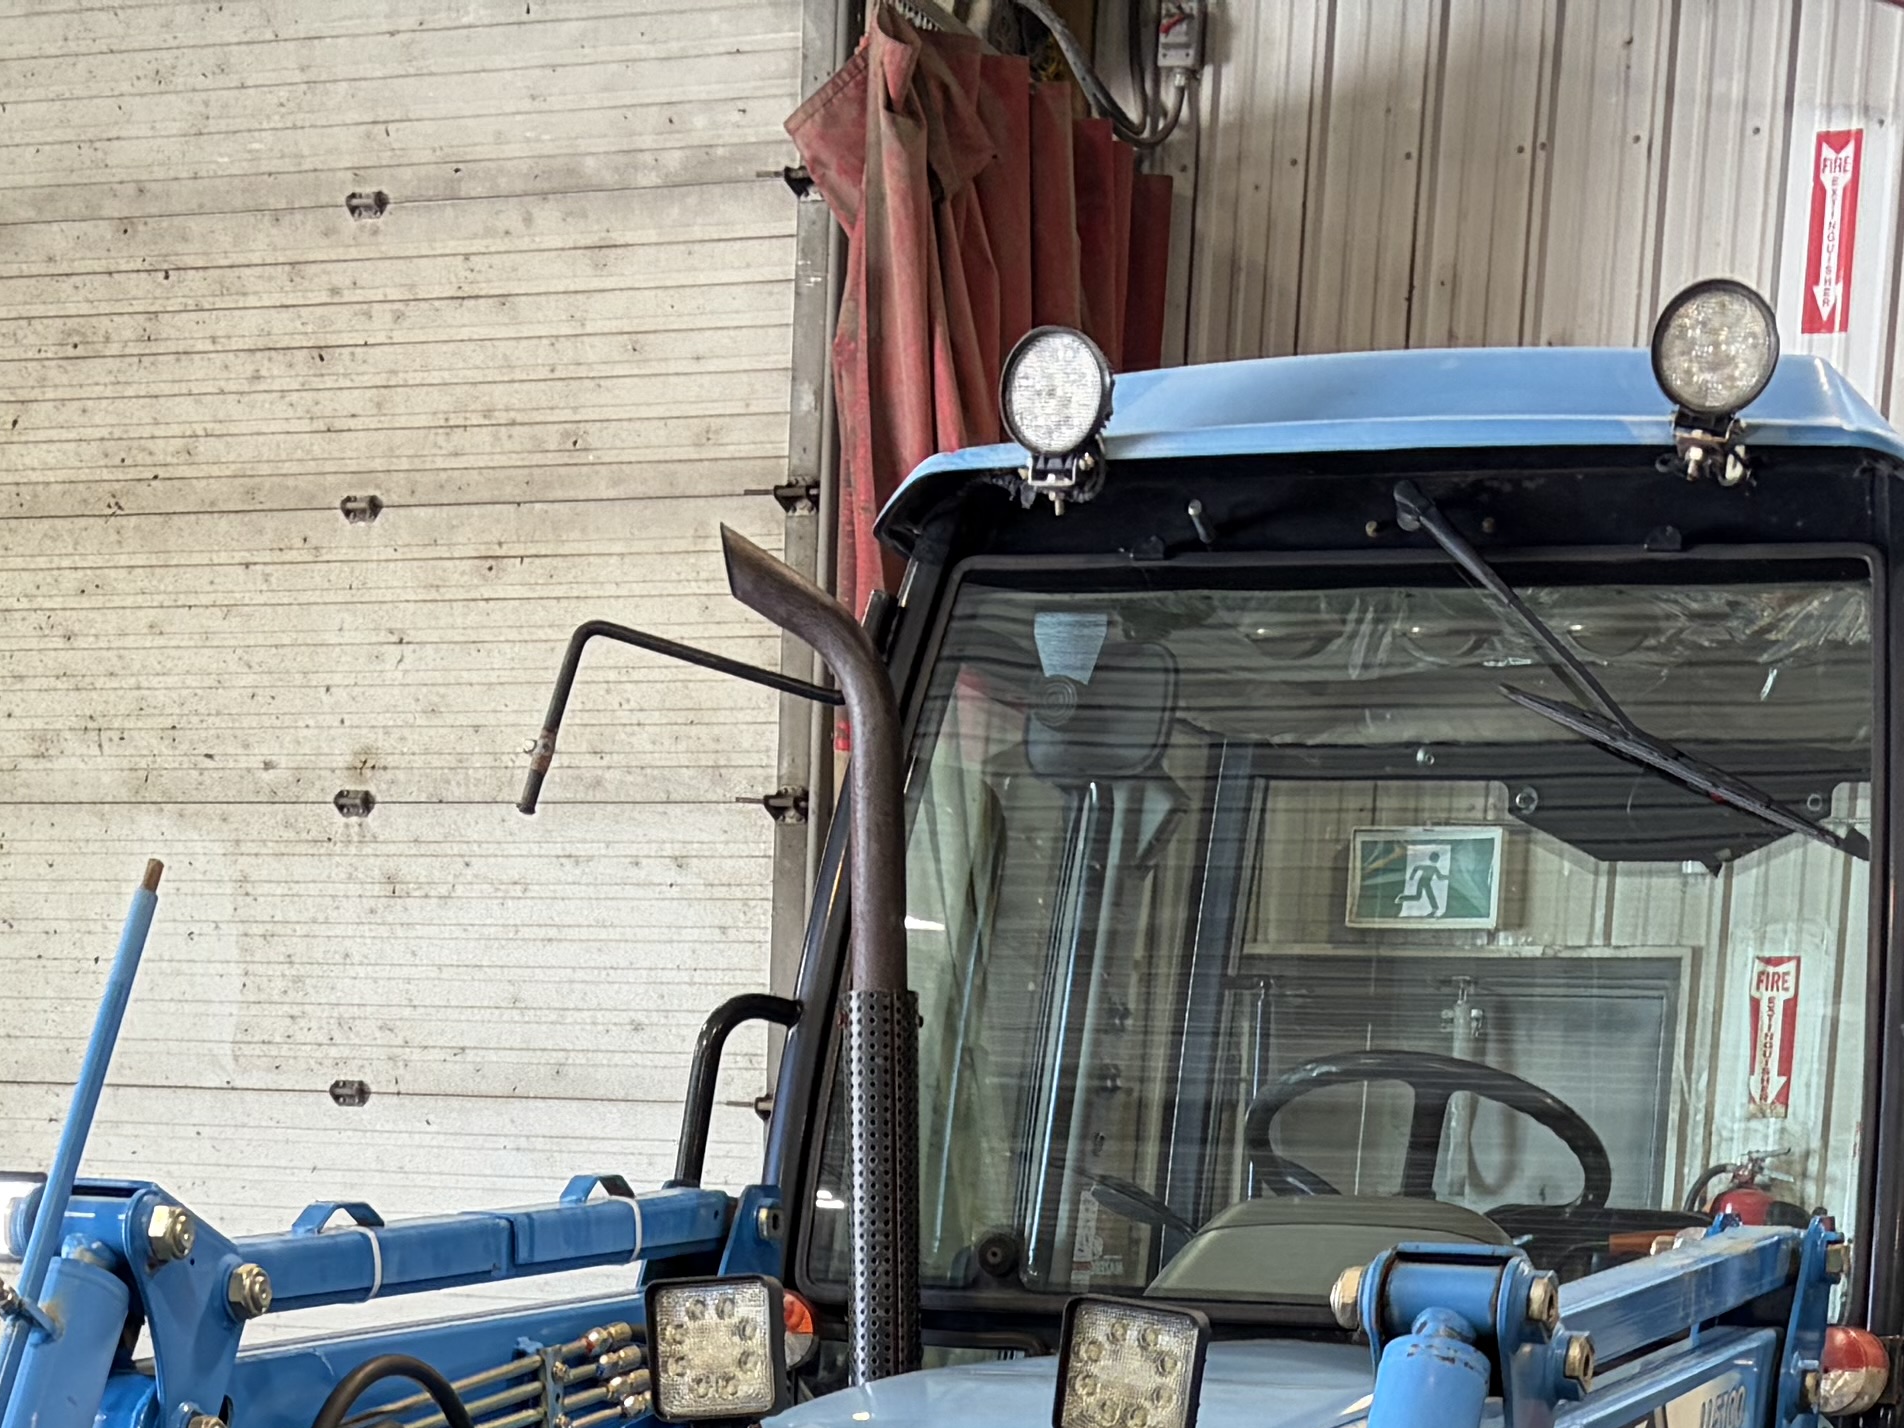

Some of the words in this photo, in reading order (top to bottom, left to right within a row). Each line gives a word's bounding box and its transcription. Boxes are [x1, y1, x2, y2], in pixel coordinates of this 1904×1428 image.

[1822, 155, 1850, 174] FIRE
[1822, 176, 1839, 307] EXTINGUISHER
[1756, 971, 1790, 992] FIRE
